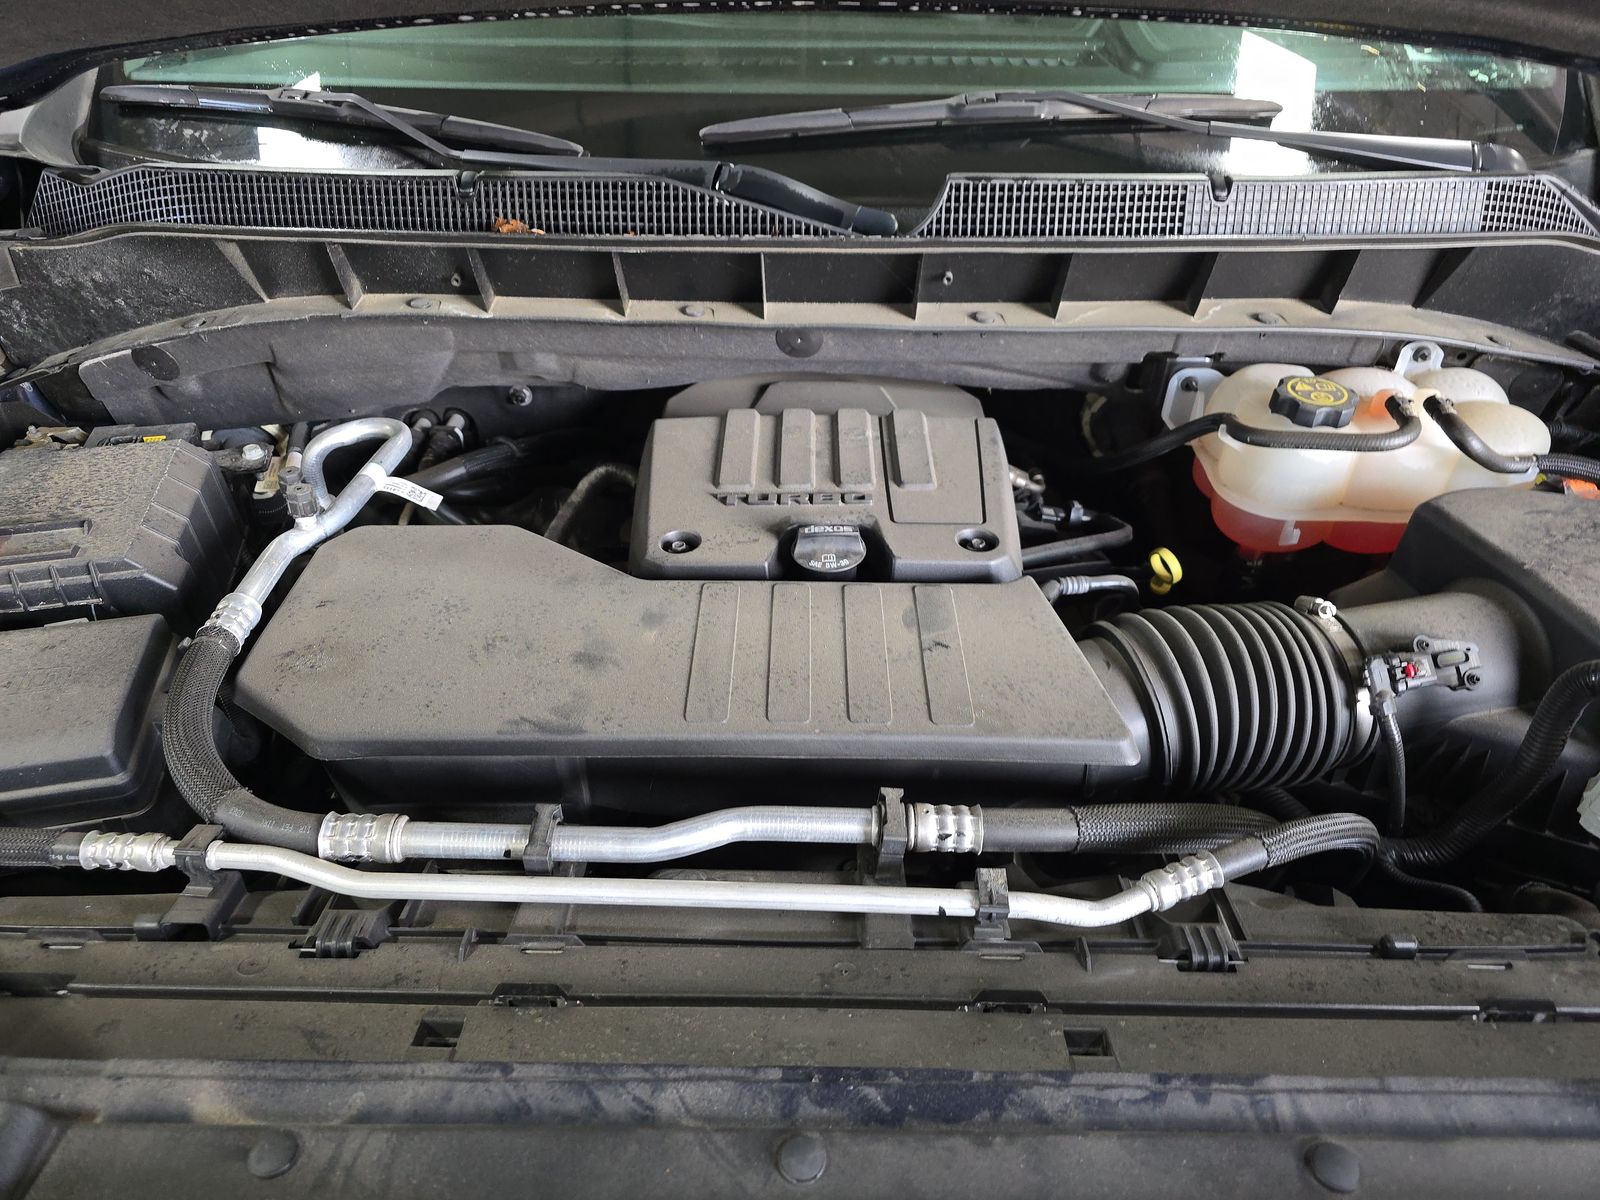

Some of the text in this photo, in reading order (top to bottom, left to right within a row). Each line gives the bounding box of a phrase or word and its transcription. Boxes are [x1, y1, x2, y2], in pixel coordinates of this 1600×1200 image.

[709, 492, 873, 506] TURBO
[804, 525, 853, 534] dexos
[808, 560, 822, 569] SAE
